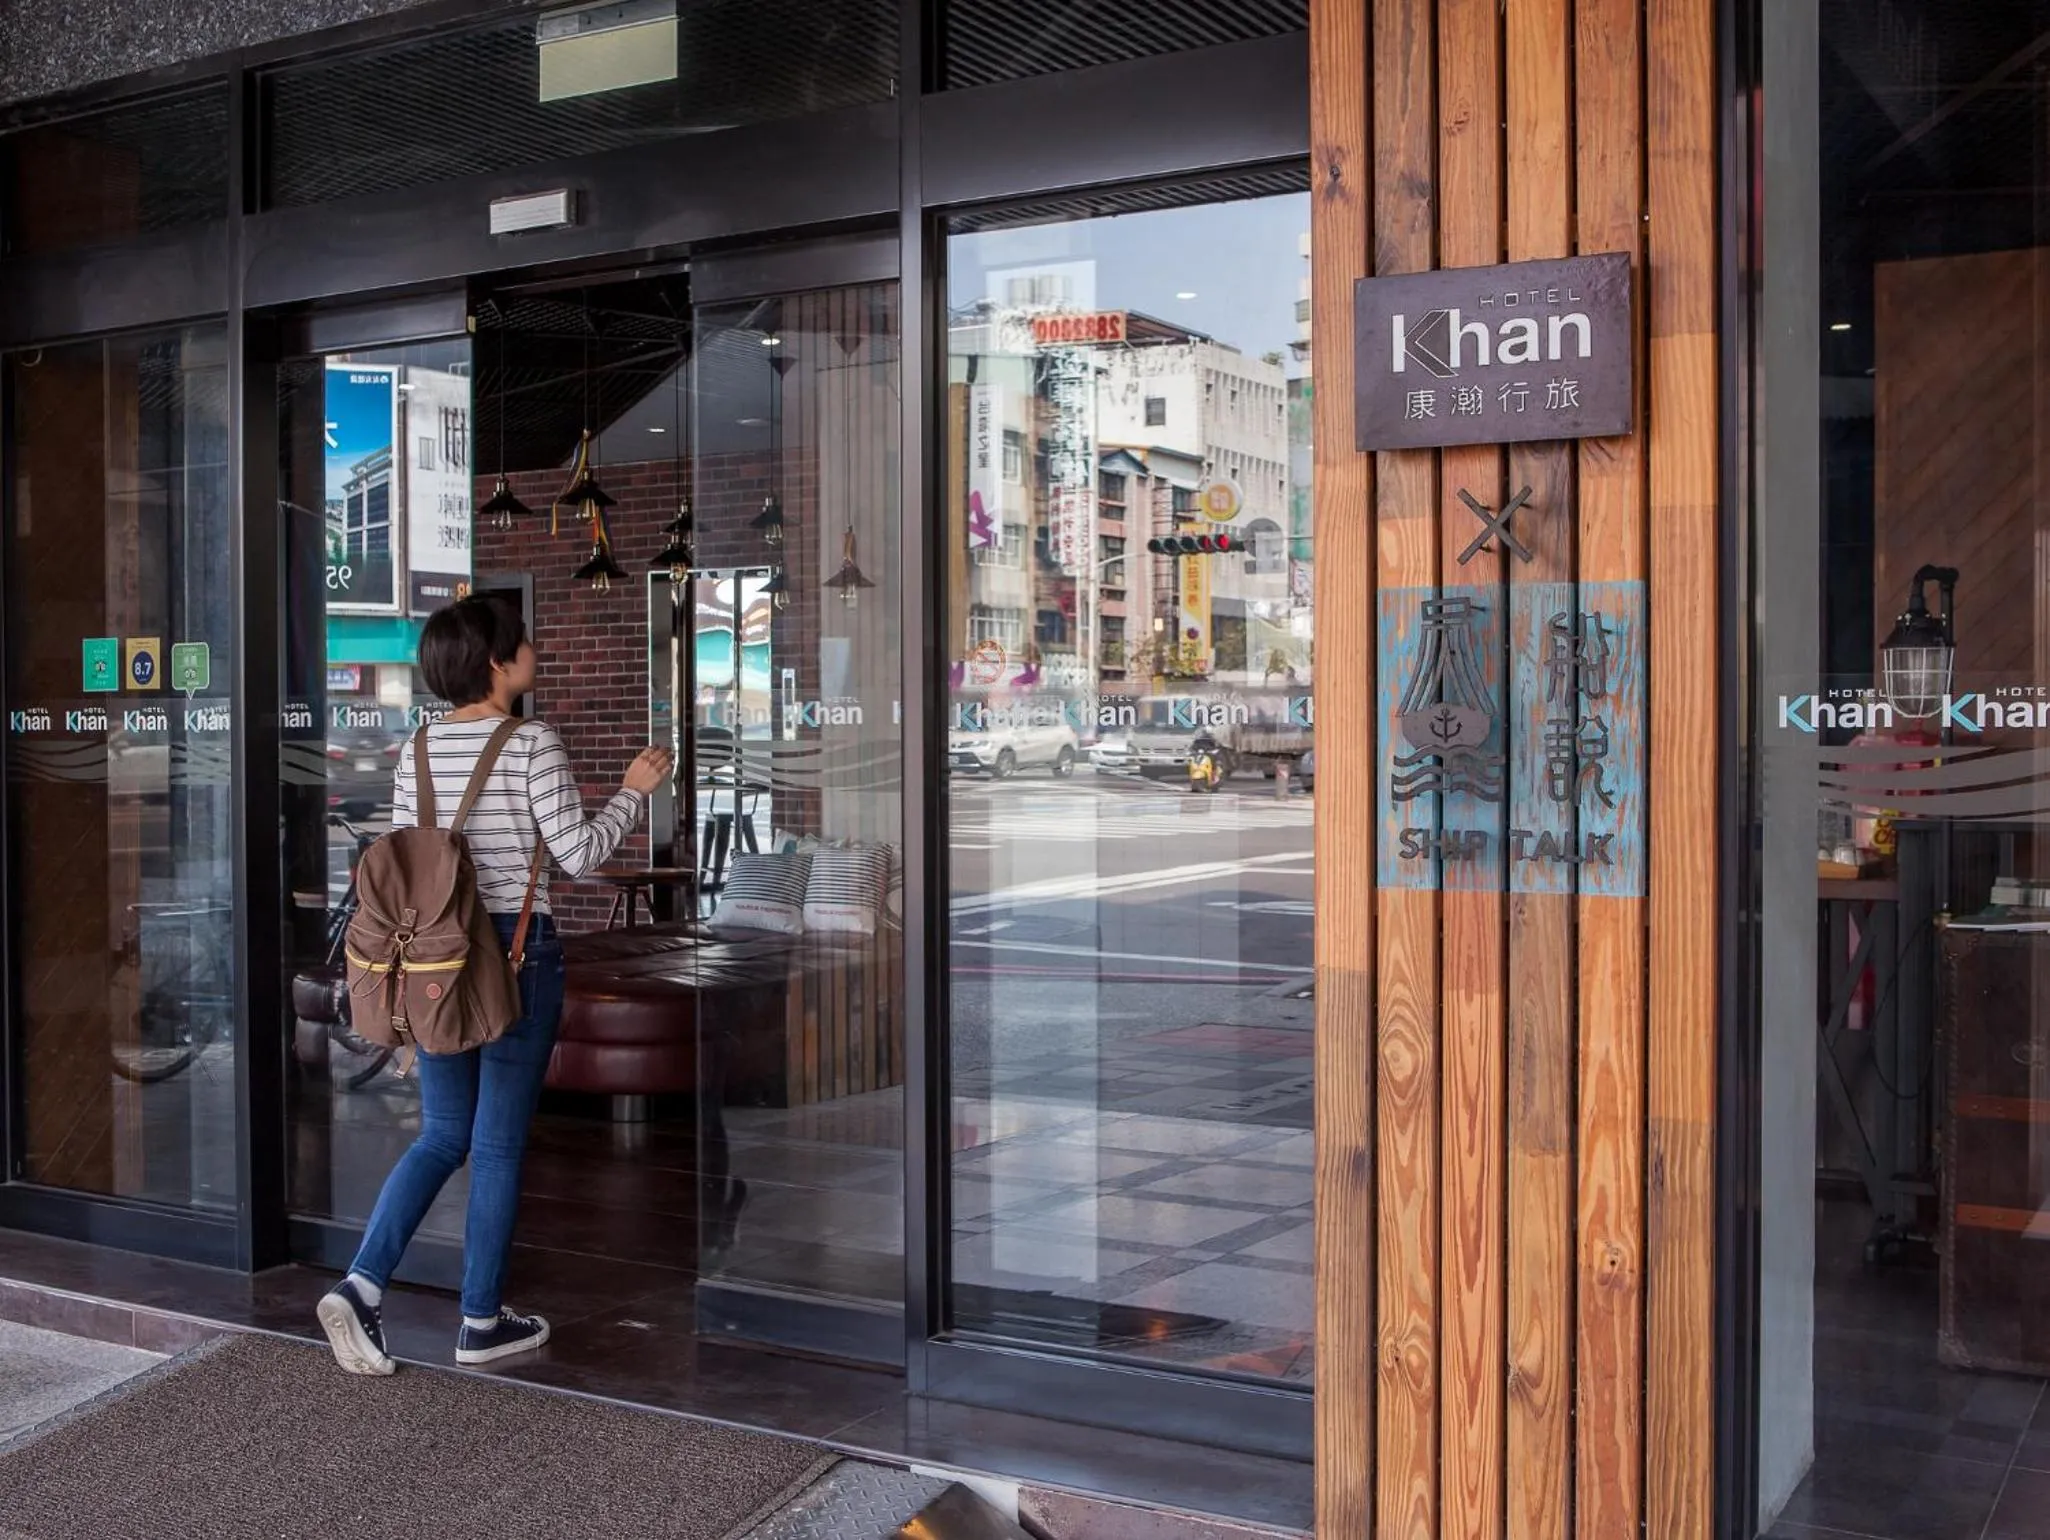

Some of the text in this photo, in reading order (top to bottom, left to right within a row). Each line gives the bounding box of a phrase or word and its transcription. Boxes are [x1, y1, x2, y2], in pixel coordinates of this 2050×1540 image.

[1478, 287, 1581, 308] HOTEL
[1391, 308, 1592, 378] Khan
[1404, 376, 1580, 419] 康瀚行旅
[134, 662, 152, 676] 8.7
[1828, 688, 1888, 698] HOTEL
[1996, 686, 2046, 697] HOTE
[10, 711, 51, 733] Khan
[65, 710, 108, 733] Khan
[123, 709, 168, 733] Khan
[281, 710, 312, 727] han
[332, 705, 382, 730] Khan
[404, 706, 453, 729] Kha
[798, 701, 863, 728] Khan
[1167, 696, 1249, 728] Khan
[1778, 694, 1893, 733] Khan
[1399, 828, 1615, 866] SHIP TALK
